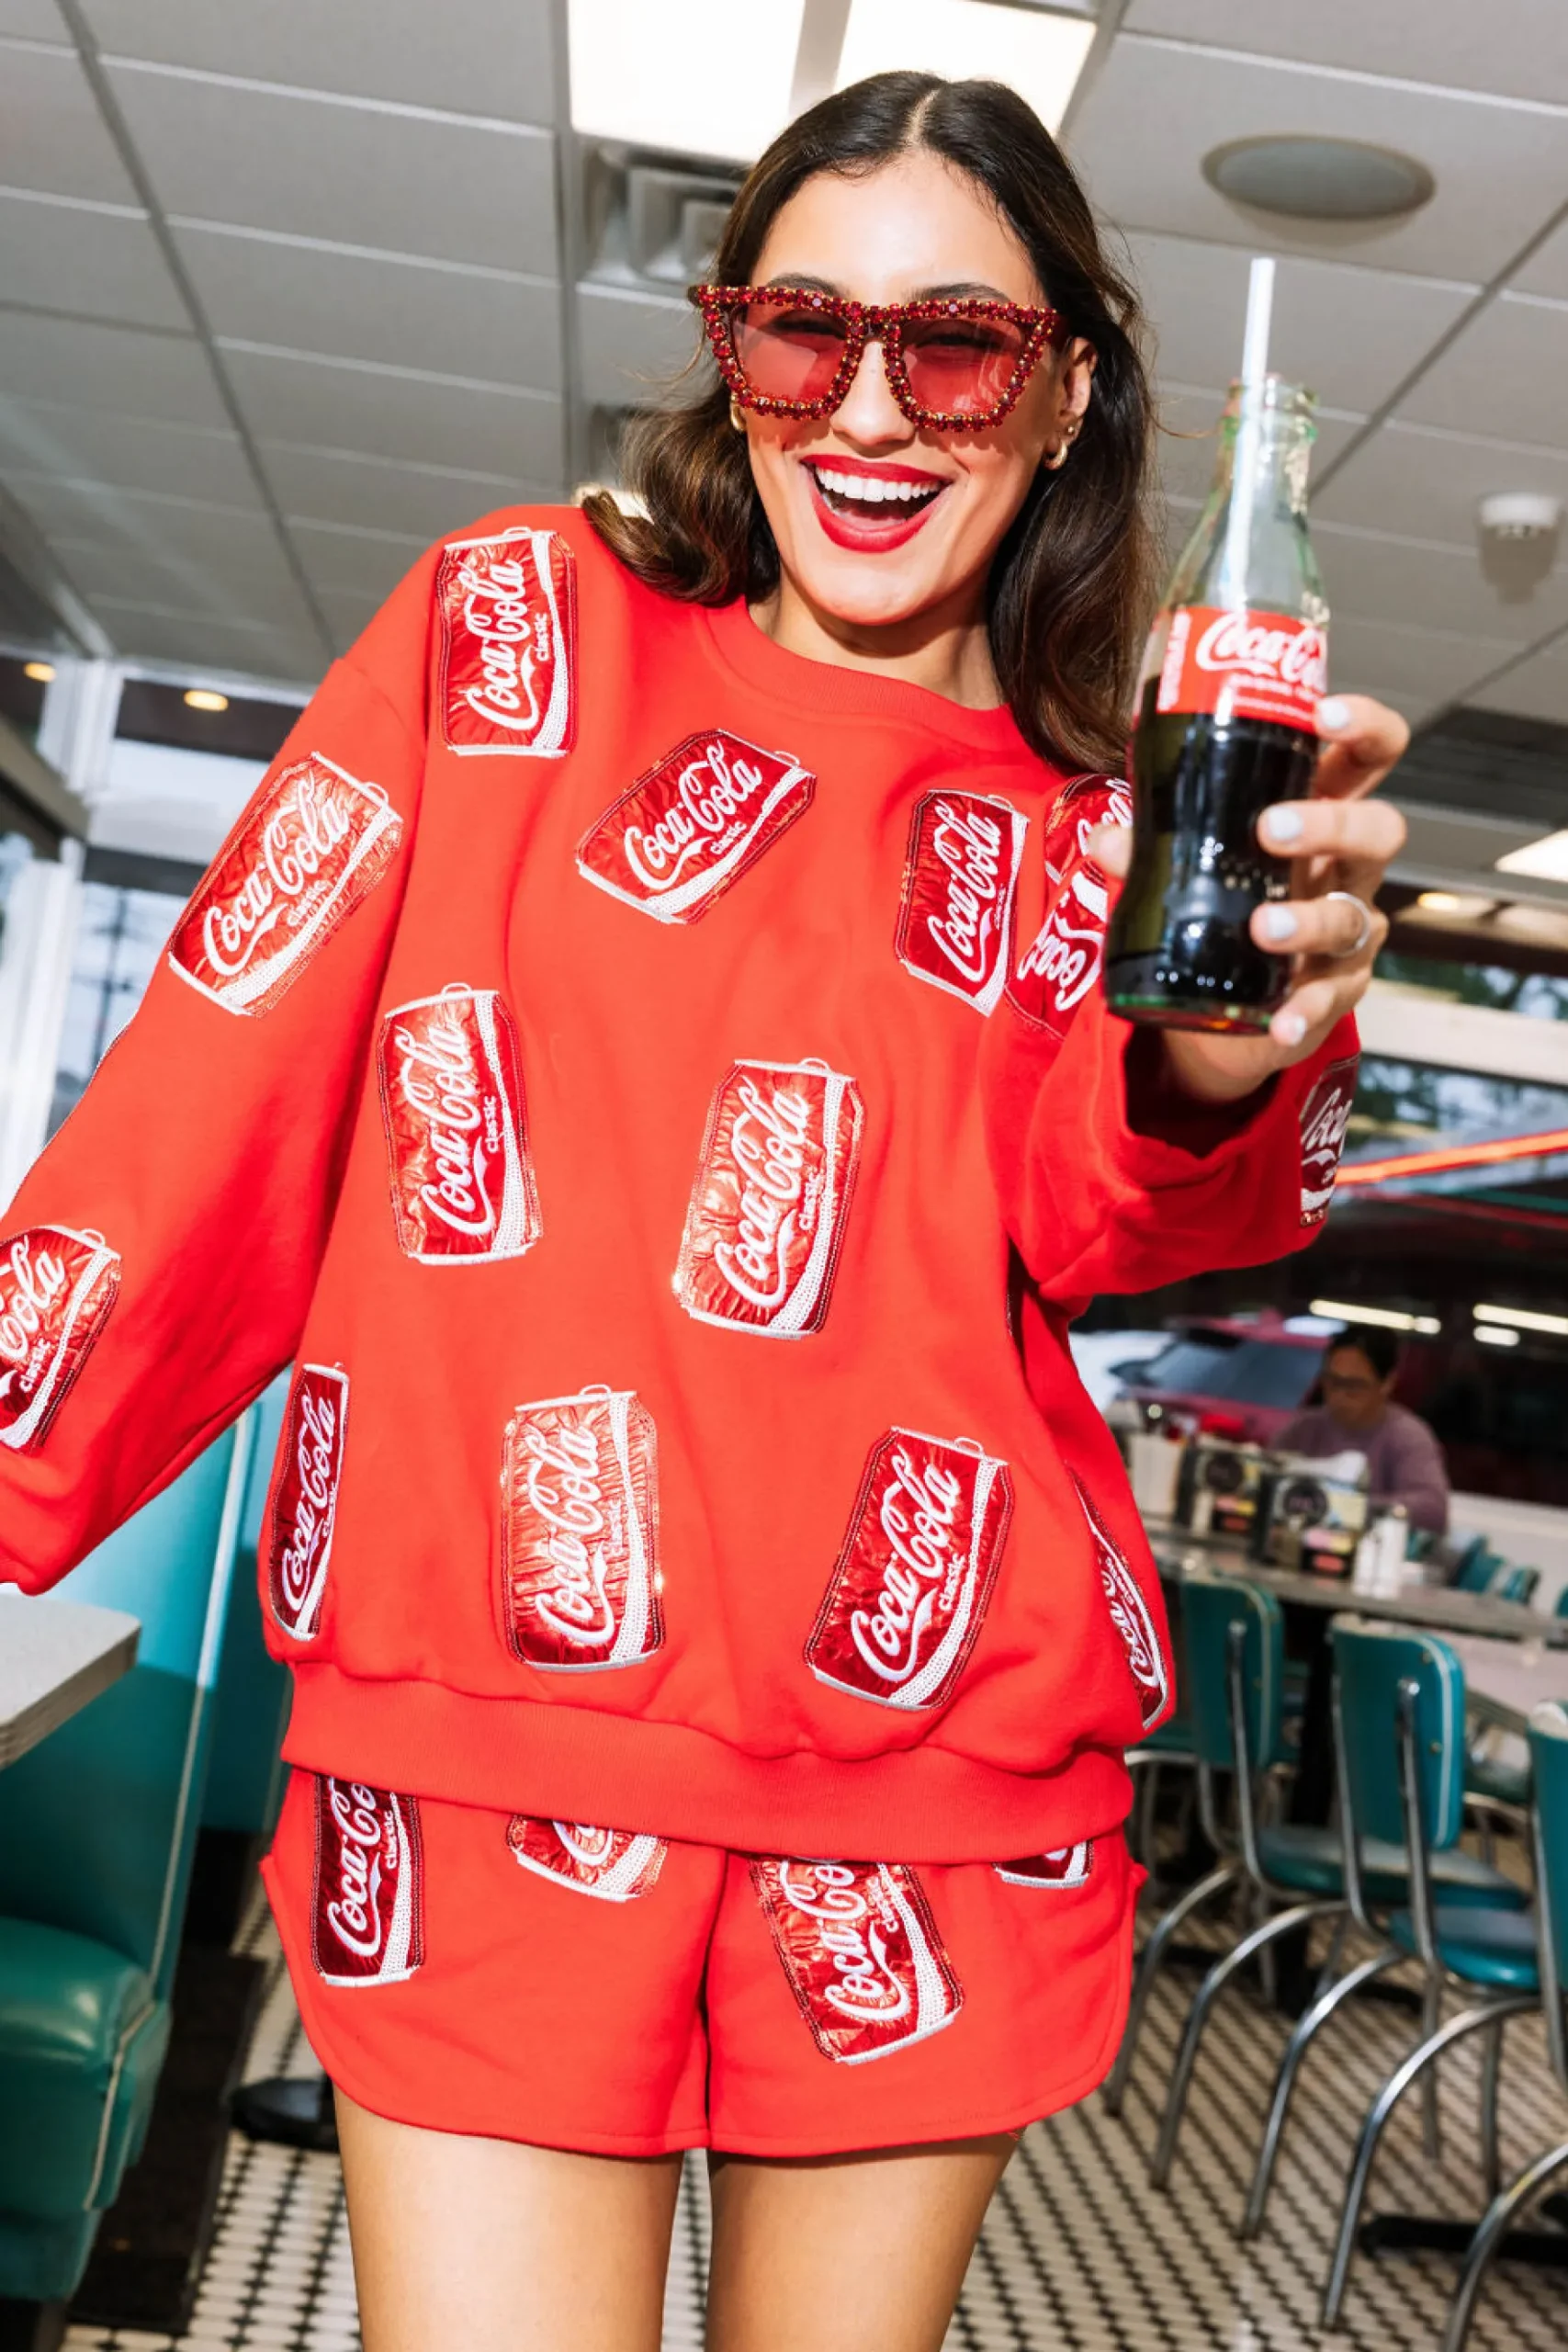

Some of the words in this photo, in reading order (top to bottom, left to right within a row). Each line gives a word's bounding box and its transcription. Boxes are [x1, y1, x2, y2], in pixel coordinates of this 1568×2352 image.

[457, 560, 539, 730] Coca-Cola
[534, 612, 549, 662] classic
[203, 770, 350, 976] Coca-Cola
[625, 740, 762, 889] Coca-Cola
[927, 799, 1001, 982] Coca-Cola
[395, 1024, 495, 1236] Coca-Cola
[714, 1075, 809, 1306] Coca-Cola
[282, 1384, 334, 1611] Coca-Cola
[526, 1423, 615, 1644] Coca-Cola
[850, 1443, 961, 1681] Coca-Cola
[327, 1777, 381, 1957] Coca-Co
[779, 1860, 910, 2020] Coca-Co
